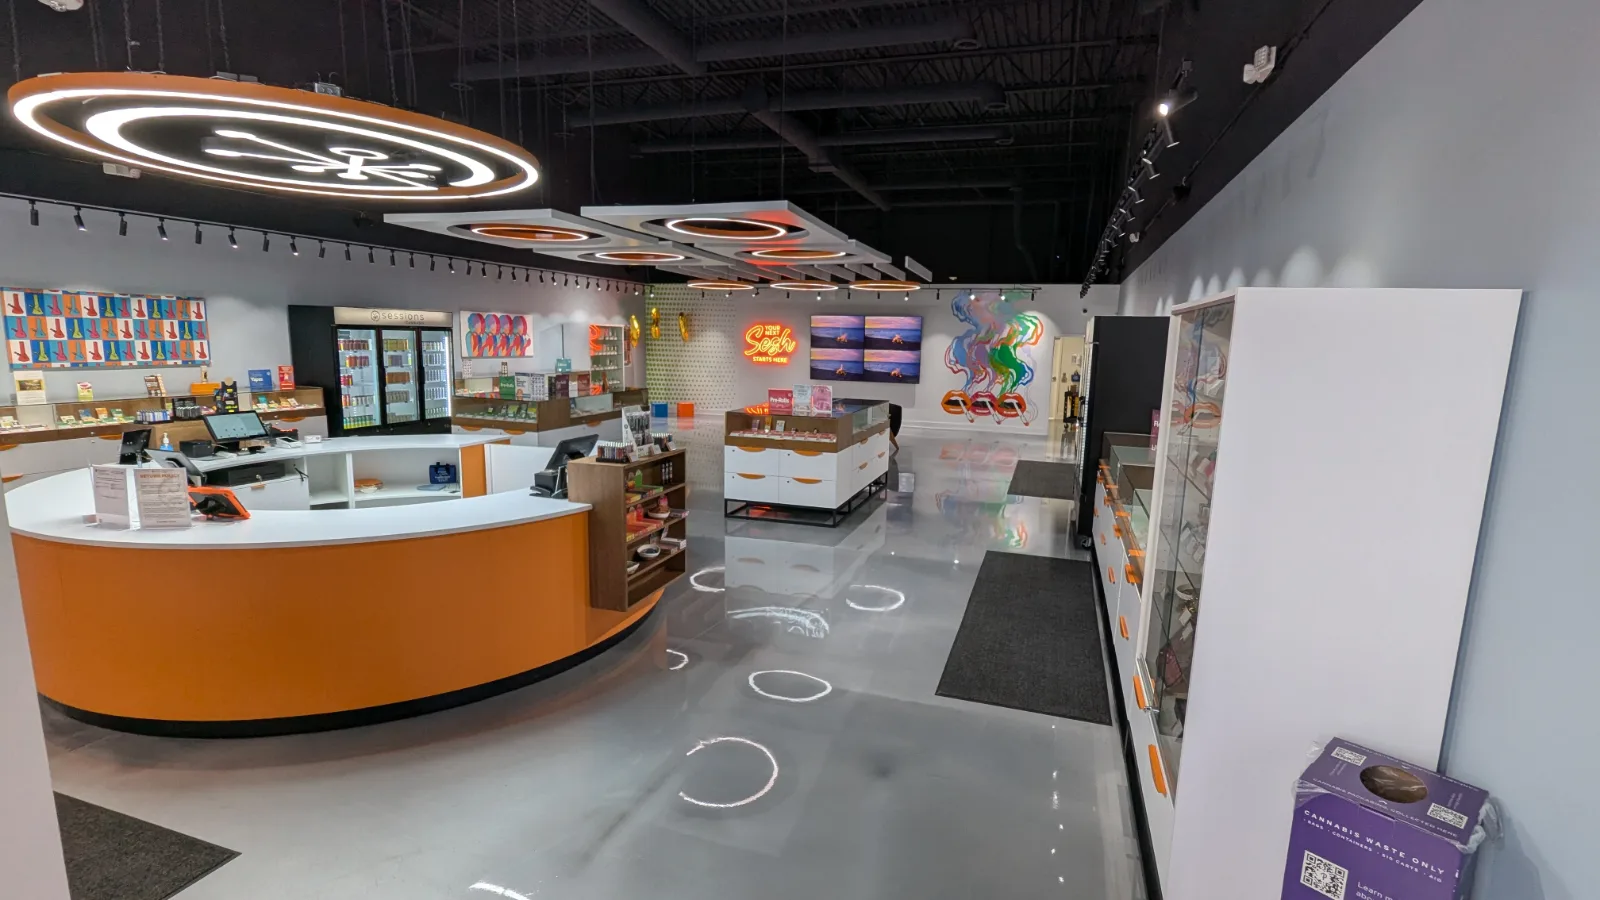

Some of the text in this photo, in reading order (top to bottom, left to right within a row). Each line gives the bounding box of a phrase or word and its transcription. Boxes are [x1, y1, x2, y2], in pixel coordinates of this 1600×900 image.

[381, 312, 425, 321] sessions
[744, 324, 796, 356] Sesh
[1304, 809, 1445, 875] CANNABIS WASTE ONLY
[1332, 831, 1373, 852] CONTAINERS
[1357, 881, 1383, 899] Learn
